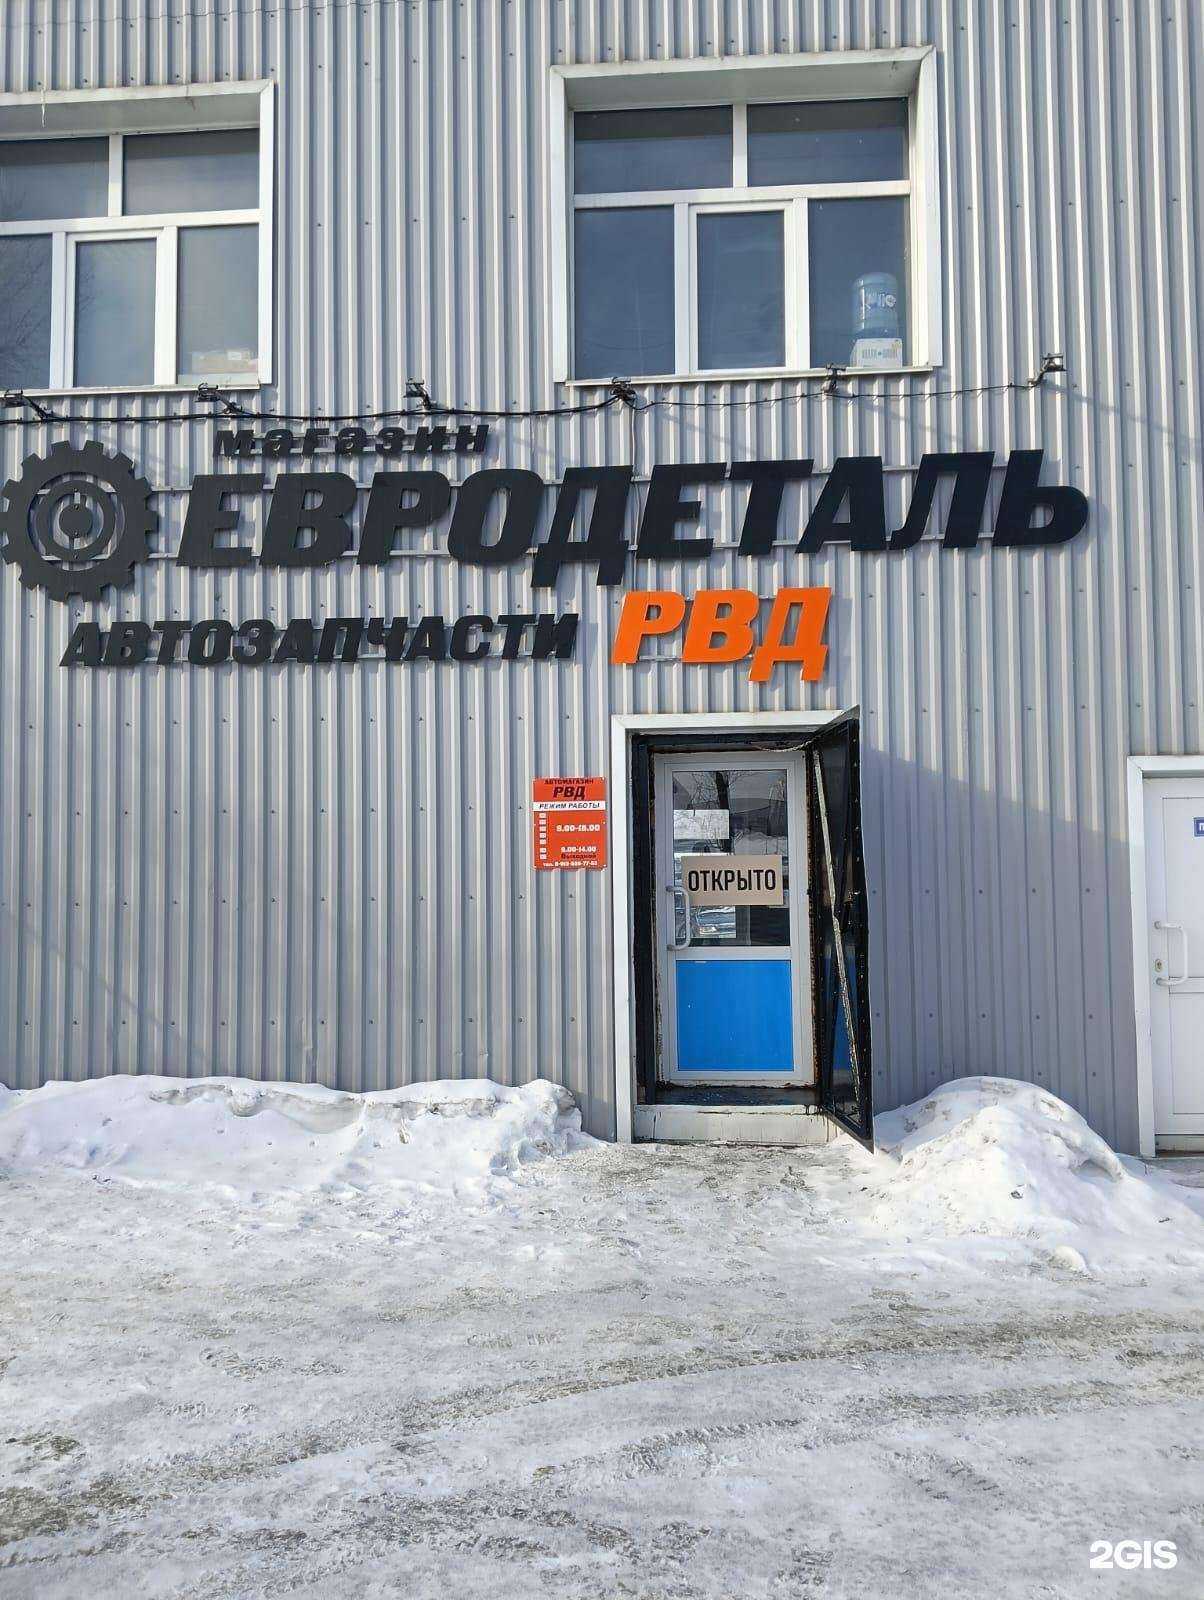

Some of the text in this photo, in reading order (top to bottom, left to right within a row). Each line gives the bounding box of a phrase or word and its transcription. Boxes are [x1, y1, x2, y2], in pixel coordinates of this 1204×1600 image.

[213, 424, 489, 458] магазин
[176, 449, 1090, 588] ЕВРОДЕТАЛЬ
[59, 612, 578, 667] АВТОЗАПЧАСТИ
[610, 586, 833, 683] РВД
[539, 802, 567, 810] РЕЖИМ
[552, 785, 586, 801] РВД
[687, 868, 777, 892] ОТКРЫТО
